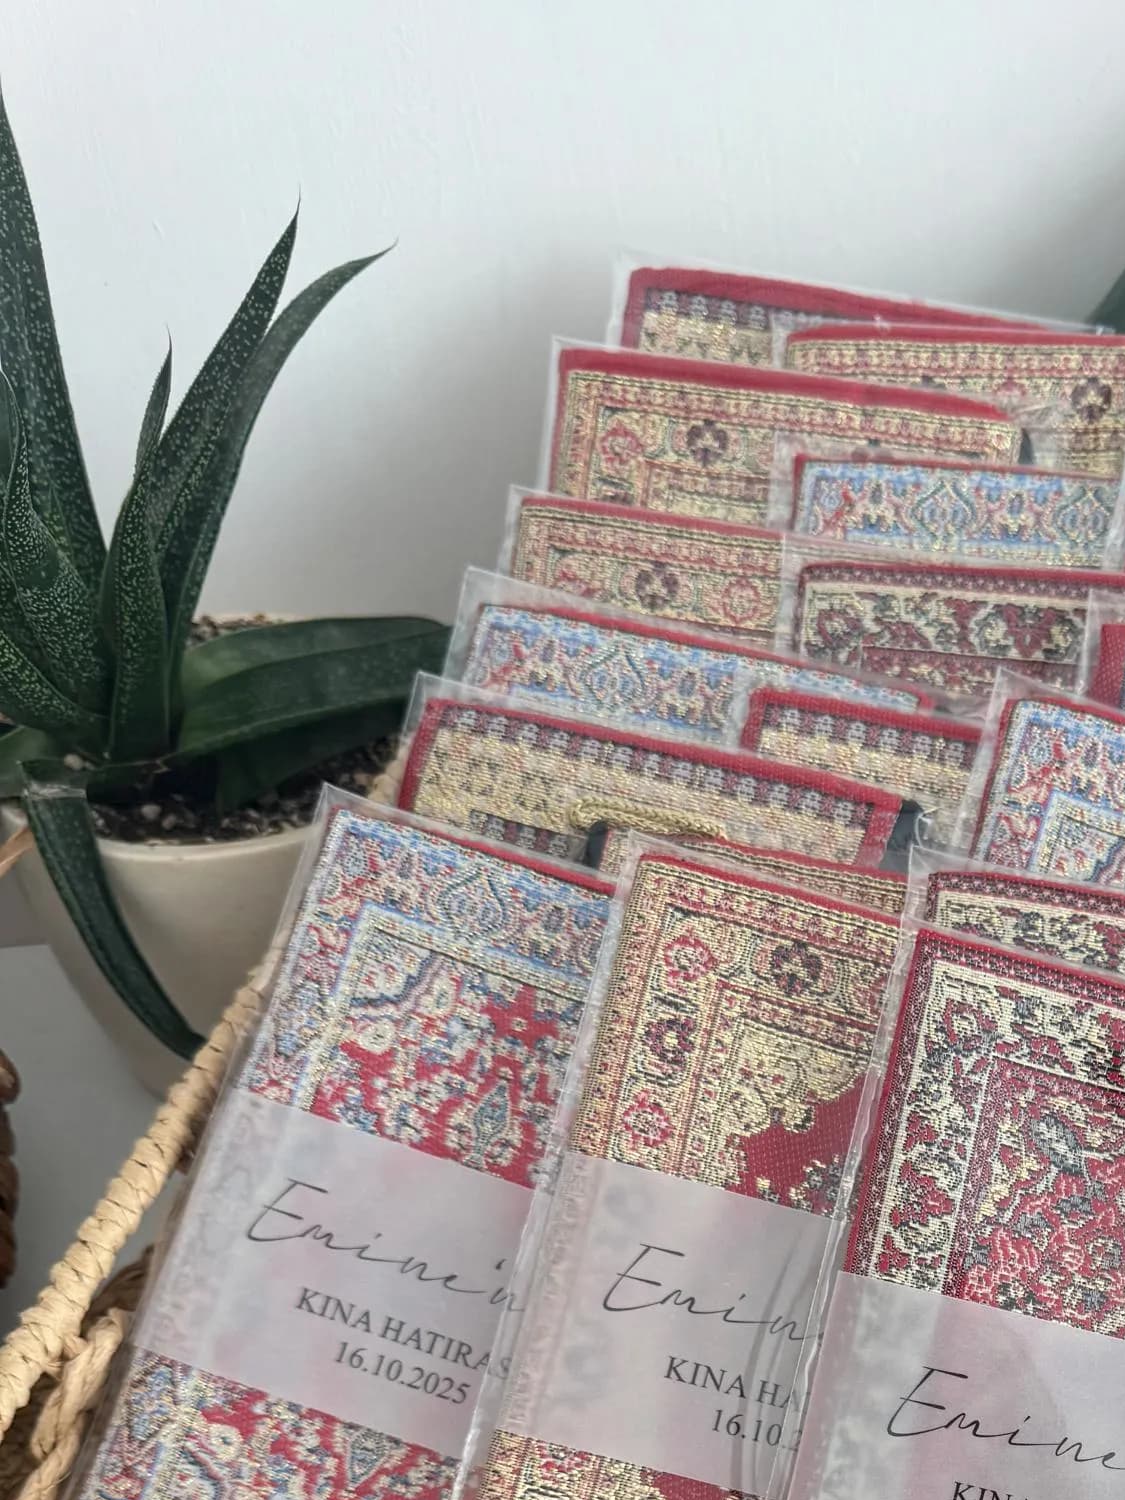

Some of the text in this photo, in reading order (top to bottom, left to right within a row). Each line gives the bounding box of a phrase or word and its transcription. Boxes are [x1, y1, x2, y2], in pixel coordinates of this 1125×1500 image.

[296, 1288, 371, 1333] KINA
[603, 1243, 824, 1347] Emin
[335, 1342, 471, 1404] 16.10.2025
[663, 1355, 747, 1398] KINA
